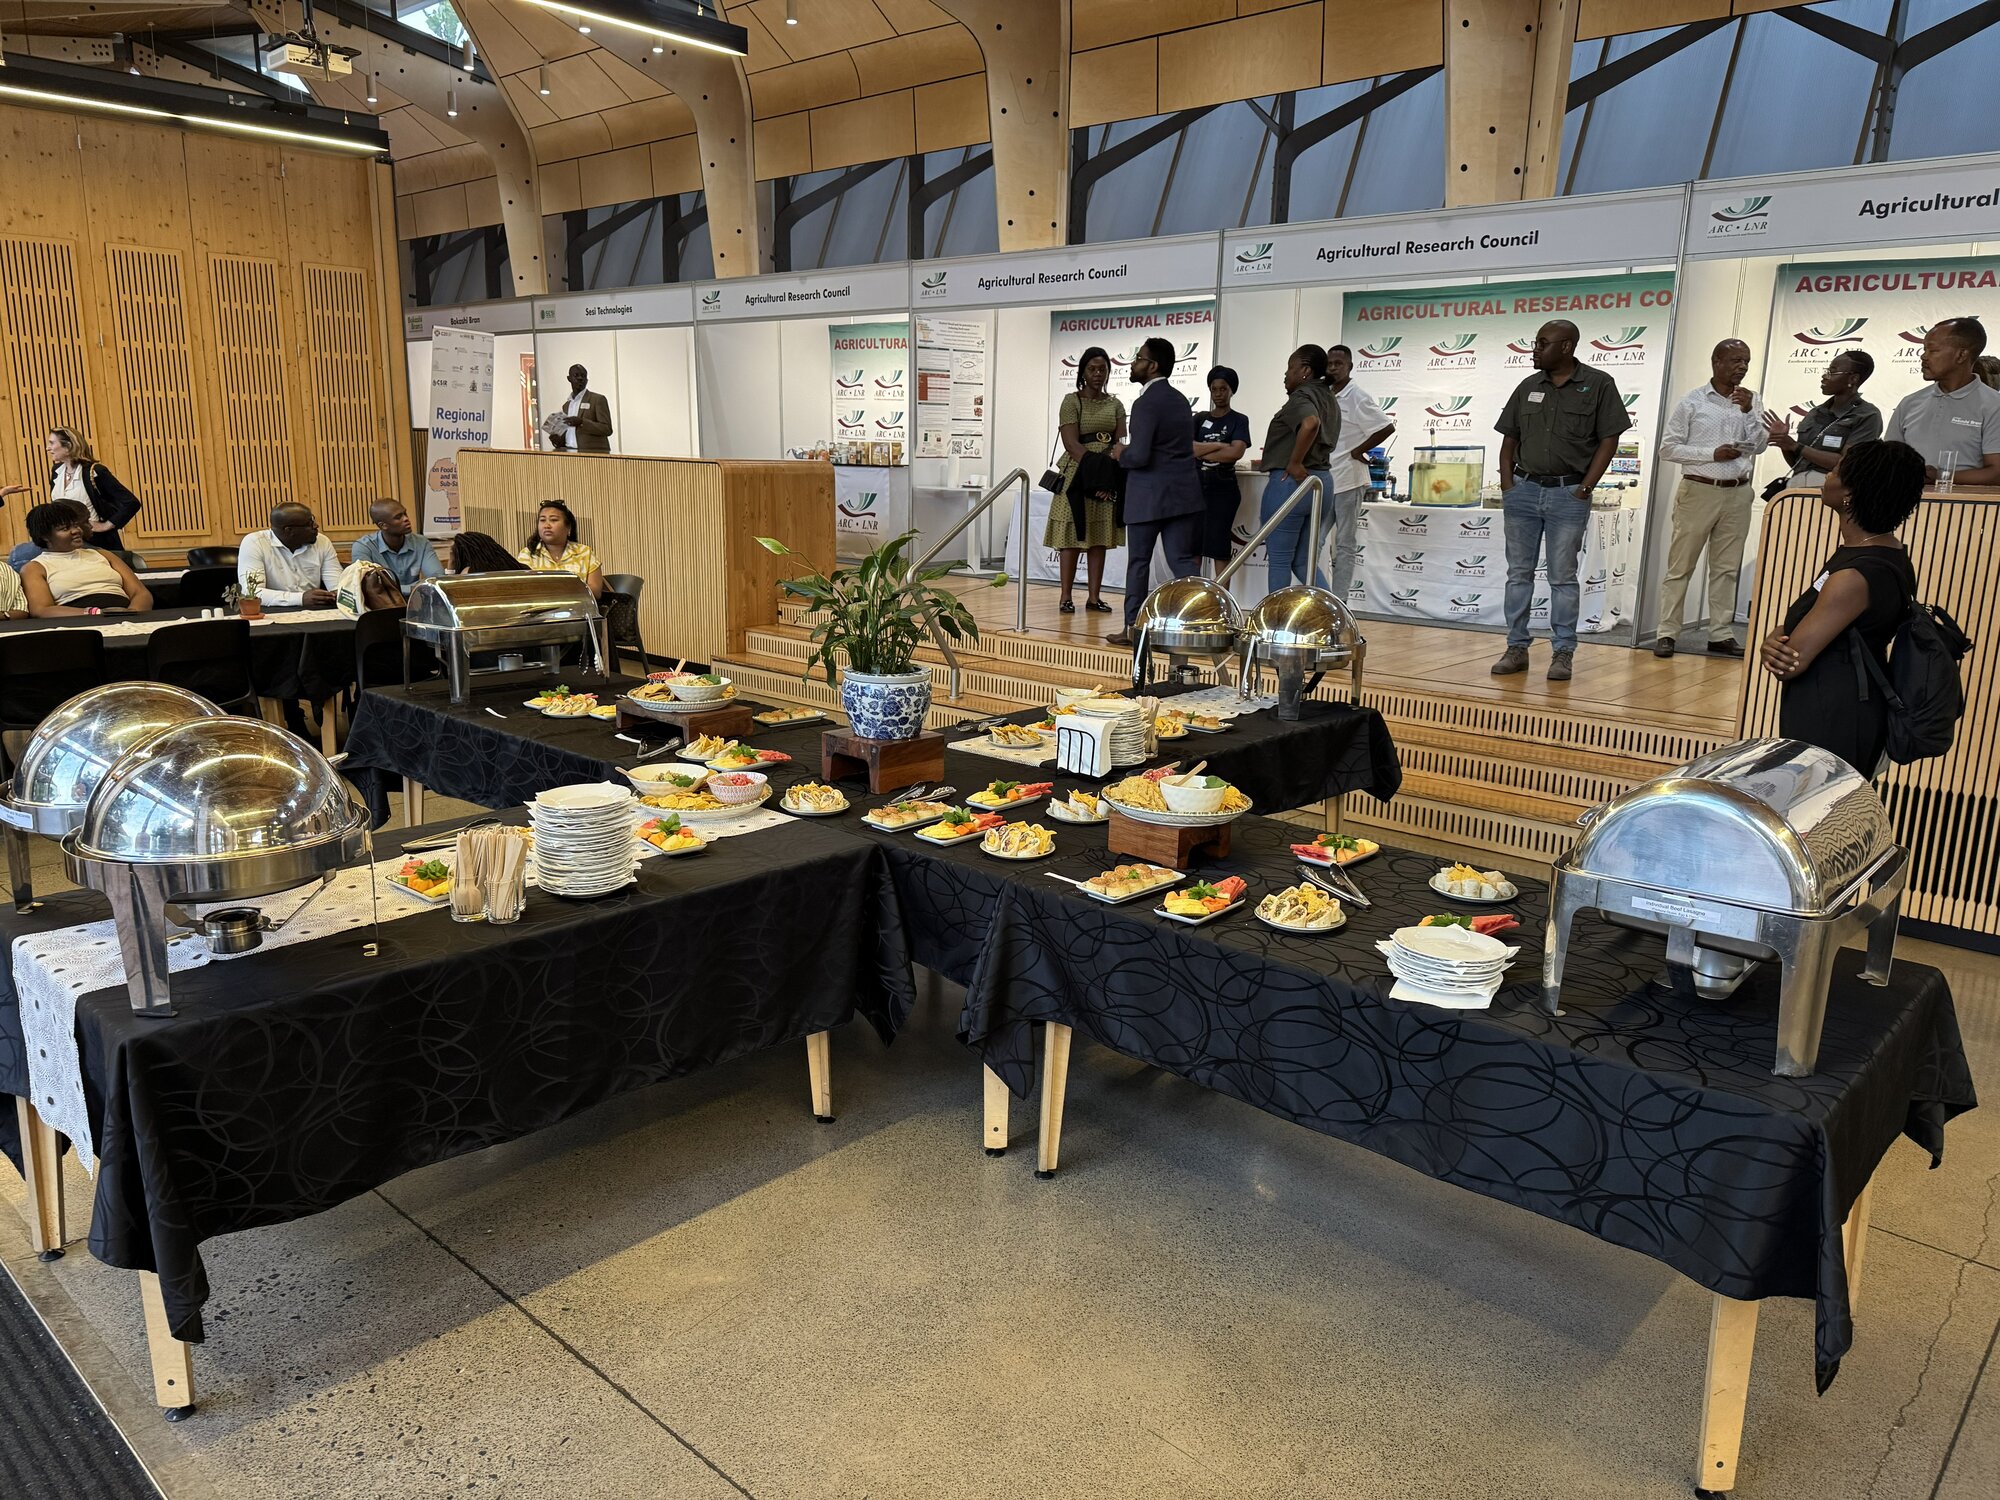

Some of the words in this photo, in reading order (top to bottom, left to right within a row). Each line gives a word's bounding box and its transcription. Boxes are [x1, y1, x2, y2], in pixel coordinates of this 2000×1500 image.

[1858, 188, 2000, 219] Agricultural
[1708, 224, 1733, 234] ARC
[1744, 221, 1768, 231] LNR
[1316, 241, 1401, 263] Agricultural
[1404, 236, 1474, 254] Research
[1480, 230, 1539, 248] Council
[1234, 264, 1249, 272] ARC
[1256, 262, 1272, 271] LNR
[978, 273, 1035, 290] Agricultural
[1038, 269, 1085, 284] Research
[1088, 264, 1127, 280] Council
[1795, 269, 2000, 293] AGRICULTURA
[745, 292, 786, 306] Agricultural
[788, 289, 821, 301] Research
[823, 286, 850, 298] Council
[585, 307, 596, 316] Sesi
[598, 304, 633, 316] Technologies
[1357, 300, 1506, 321] AGRICULTURAL
[1514, 292, 1632, 314] RESEARCH
[450, 316, 468, 325] Bokashi
[469, 316, 480, 324] Bran
[1060, 314, 1161, 332] AGRICULTURAL
[1166, 310, 1216, 326] RESEA
[834, 338, 909, 350] AGRICULTURA
[1588, 352, 1610, 362] ARC
[1624, 352, 1646, 360] LNR
[1787, 348, 1819, 357] ARC
[1894, 348, 1922, 356] ARC
[1357, 360, 1374, 368] ARC
[1384, 360, 1402, 368] LNR
[1428, 358, 1447, 366] ARC
[1458, 357, 1476, 366] LNR
[1504, 356, 1526, 364] ARC
[436, 407, 485, 423] Regional
[432, 426, 488, 444] Workshop
[838, 519, 853, 528] ARC
[862, 520, 878, 530] LNR
[1046, 552, 1060, 562] AR
